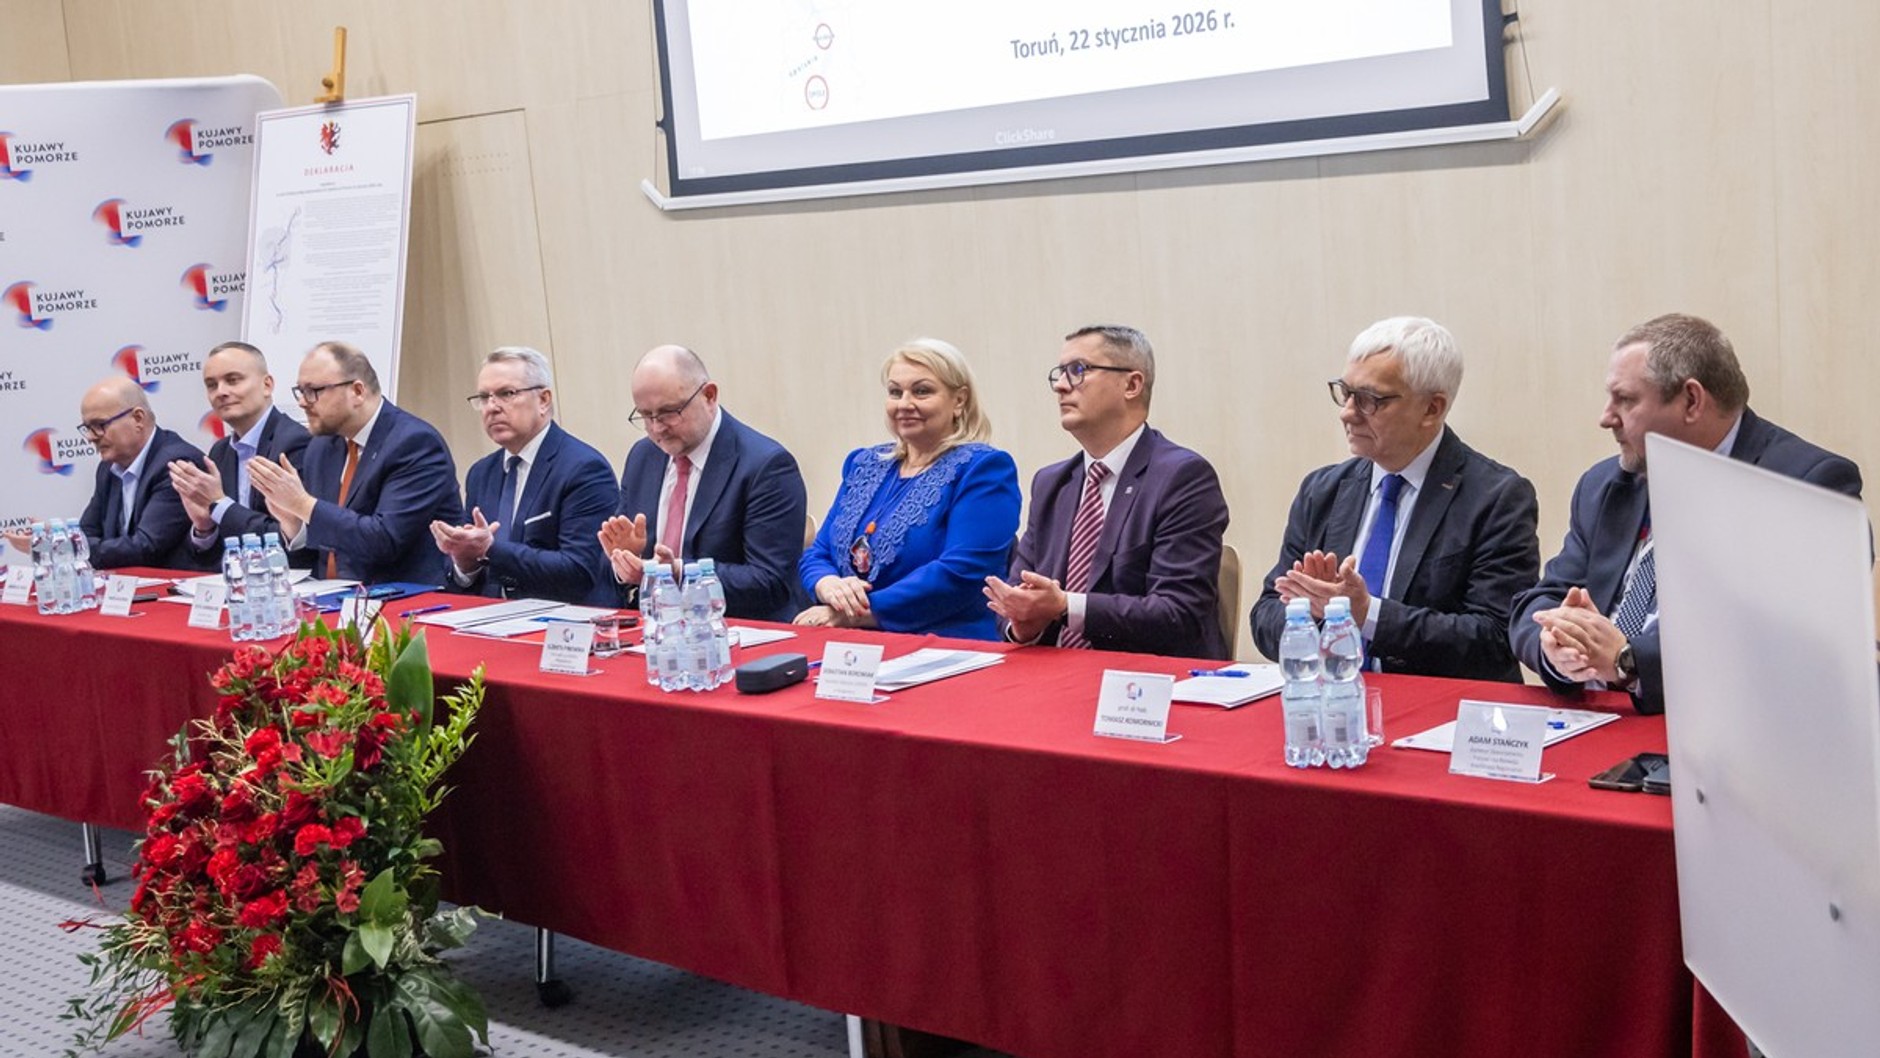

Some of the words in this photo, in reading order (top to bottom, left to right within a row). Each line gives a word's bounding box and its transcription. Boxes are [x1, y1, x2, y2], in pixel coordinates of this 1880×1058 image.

[1010, 32, 1064, 58] Toruń,
[1069, 29, 1090, 51] 22
[1095, 19, 1166, 50] stycznia
[1171, 9, 1218, 36] 2026
[1223, 11, 1235, 28] r.
[197, 126, 243, 138] KUJAWY
[995, 128, 1055, 145] ClickShare
[14, 142, 65, 153] KUJAWY
[198, 134, 254, 148] POMORZE
[16, 151, 78, 164] POMORZE
[126, 206, 174, 219] KUJAWY
[127, 215, 186, 230] POMORZE
[36, 289, 85, 302] KUJAWY
[37, 299, 97, 313] POMORZE
[143, 352, 190, 366] KUJAWY
[145, 361, 202, 376] POMORZE
[1467, 735, 1492, 745] ADAM
[1492, 737, 1529, 749] STAŃCZYK
